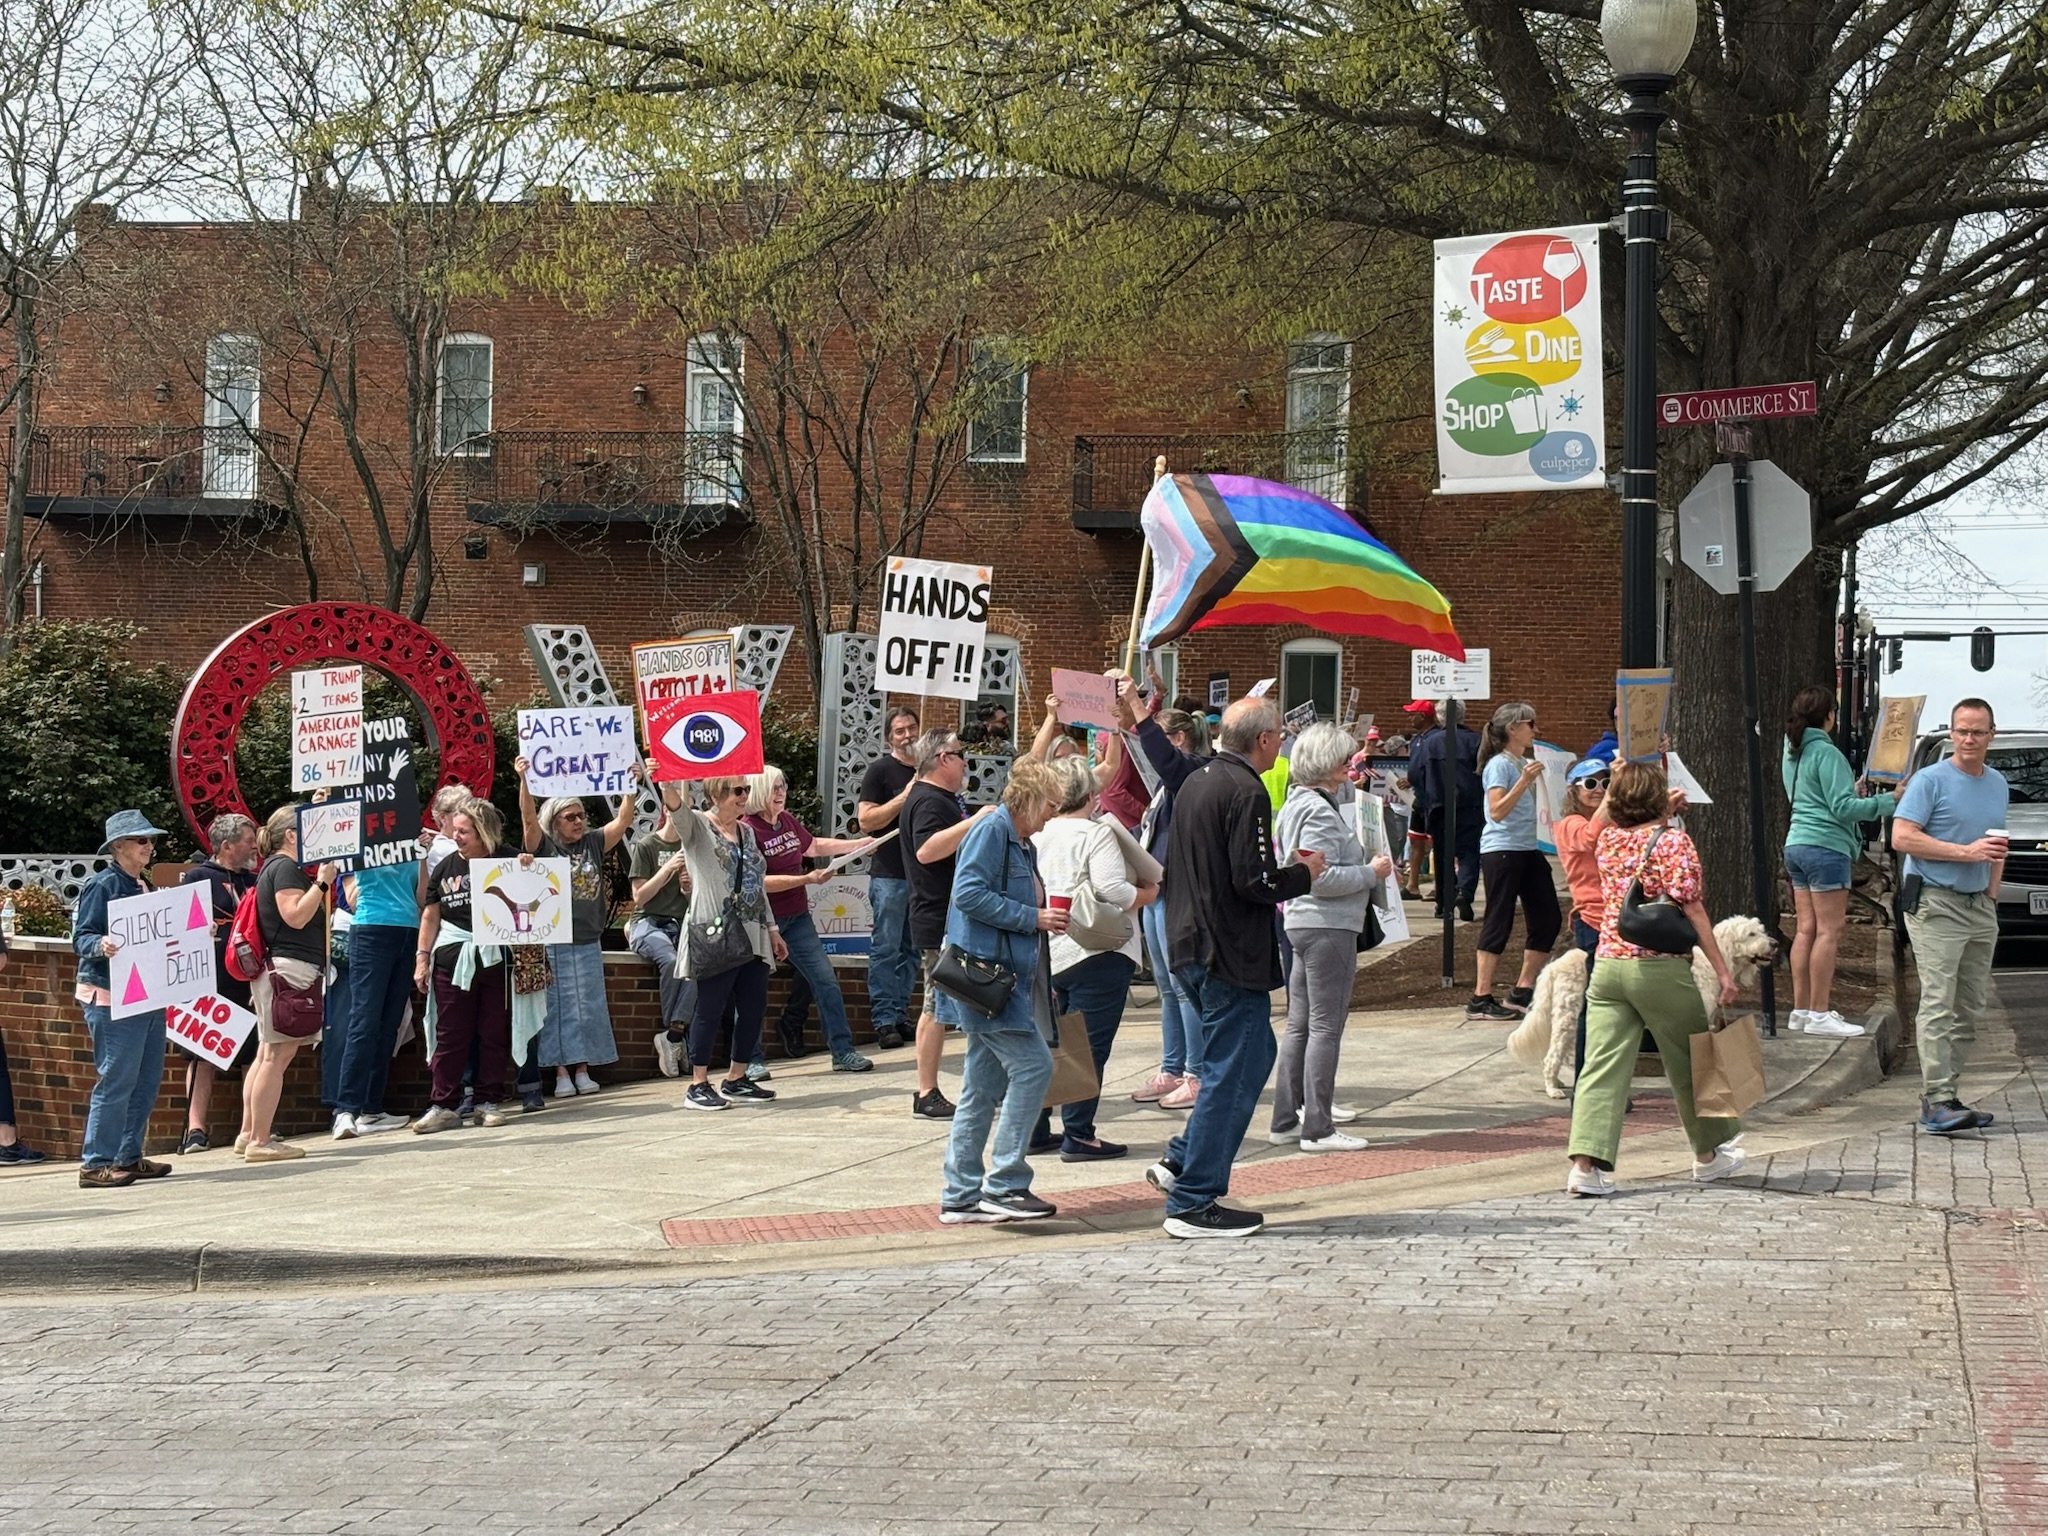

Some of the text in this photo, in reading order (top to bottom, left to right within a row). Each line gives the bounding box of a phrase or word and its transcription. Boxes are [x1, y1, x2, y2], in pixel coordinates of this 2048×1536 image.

[1470, 272, 1543, 311] TASTE
[1525, 330, 1582, 363] DINE
[1443, 399, 1504, 432] SHOP
[1686, 393, 1784, 421] COMMERCE
[1541, 456, 1591, 471] culpeper
[885, 572, 990, 623] HANDS
[638, 645, 693, 677] HANDS
[1417, 653, 1451, 664] SHARE
[1417, 665, 1437, 674] THE
[321, 669, 362, 687] TRUMP
[1418, 675, 1446, 685] LOVE
[322, 692, 359, 707] TERMS
[298, 714, 360, 736] AMERICAN
[363, 716, 409, 744] YOUR
[596, 715, 622, 737] WE
[689, 728, 719, 743] 1984
[298, 733, 357, 754] CARNAGE
[364, 753, 384, 773] NY
[532, 745, 611, 778] GREAT
[302, 763, 322, 783] 86
[330, 805, 360, 820] HANDS
[365, 810, 397, 837] FF
[334, 820, 355, 833] OFF
[1257, 816, 1267, 862] TOMMY
[305, 843, 356, 861] OUR PARKS
[363, 839, 428, 869] RIGHTS
[498, 860, 514, 876] MY
[110, 907, 174, 949] SILENCE
[819, 917, 860, 934] VOTE
[166, 949, 210, 987] DEATH
[193, 995, 231, 1024] NO
[165, 1005, 237, 1059] KINGS
